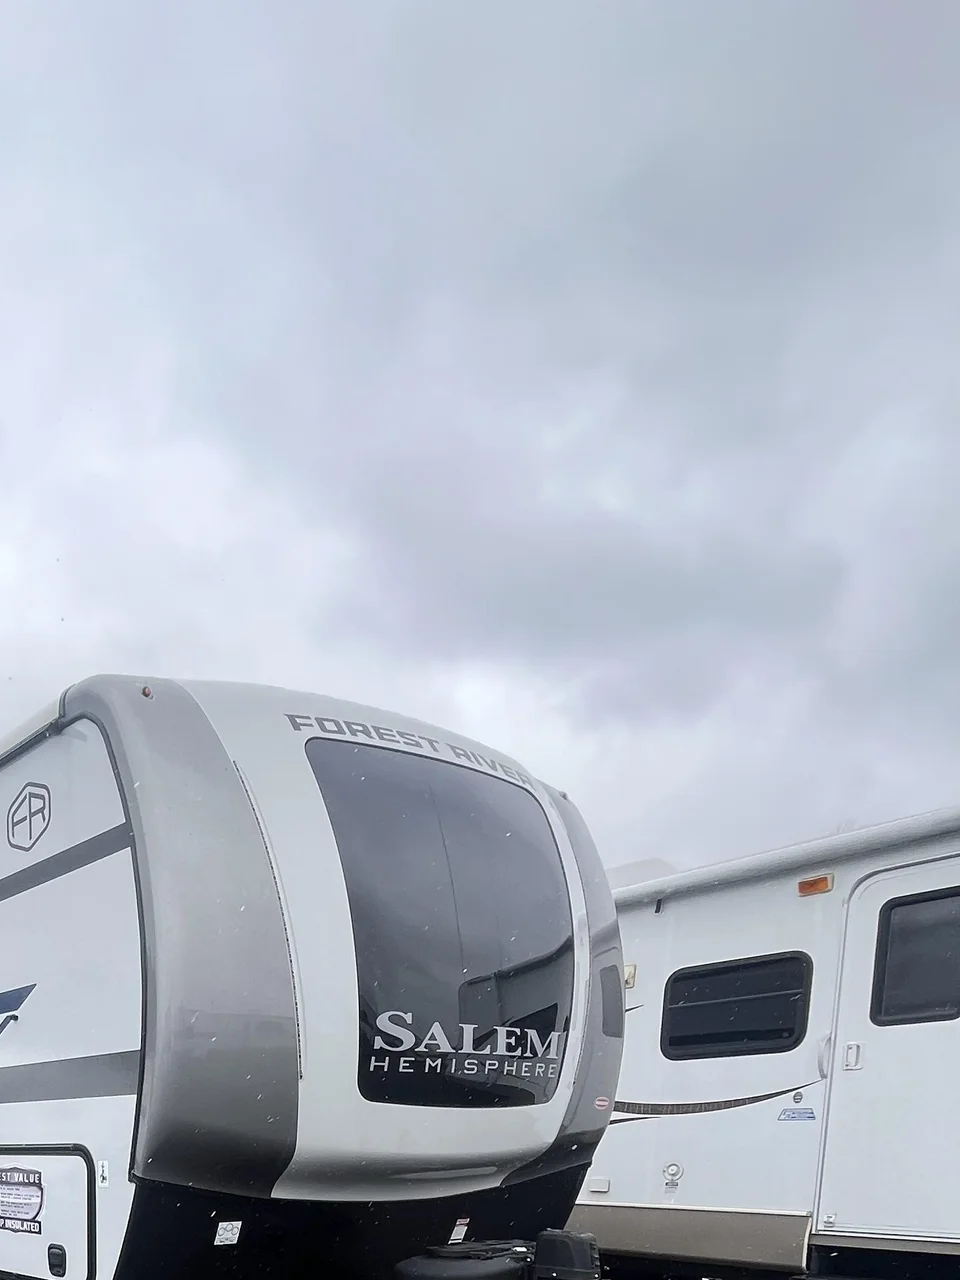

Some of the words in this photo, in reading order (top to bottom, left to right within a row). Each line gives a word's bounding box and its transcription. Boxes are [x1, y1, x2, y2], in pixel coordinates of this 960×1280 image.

[284, 714, 439, 752] FOREST
[446, 742, 538, 791] RIVER
[373, 1011, 562, 1059] SALEM
[369, 1056, 558, 1078] HEMISPHERE
[14, 1173, 40, 1183] VALUE
